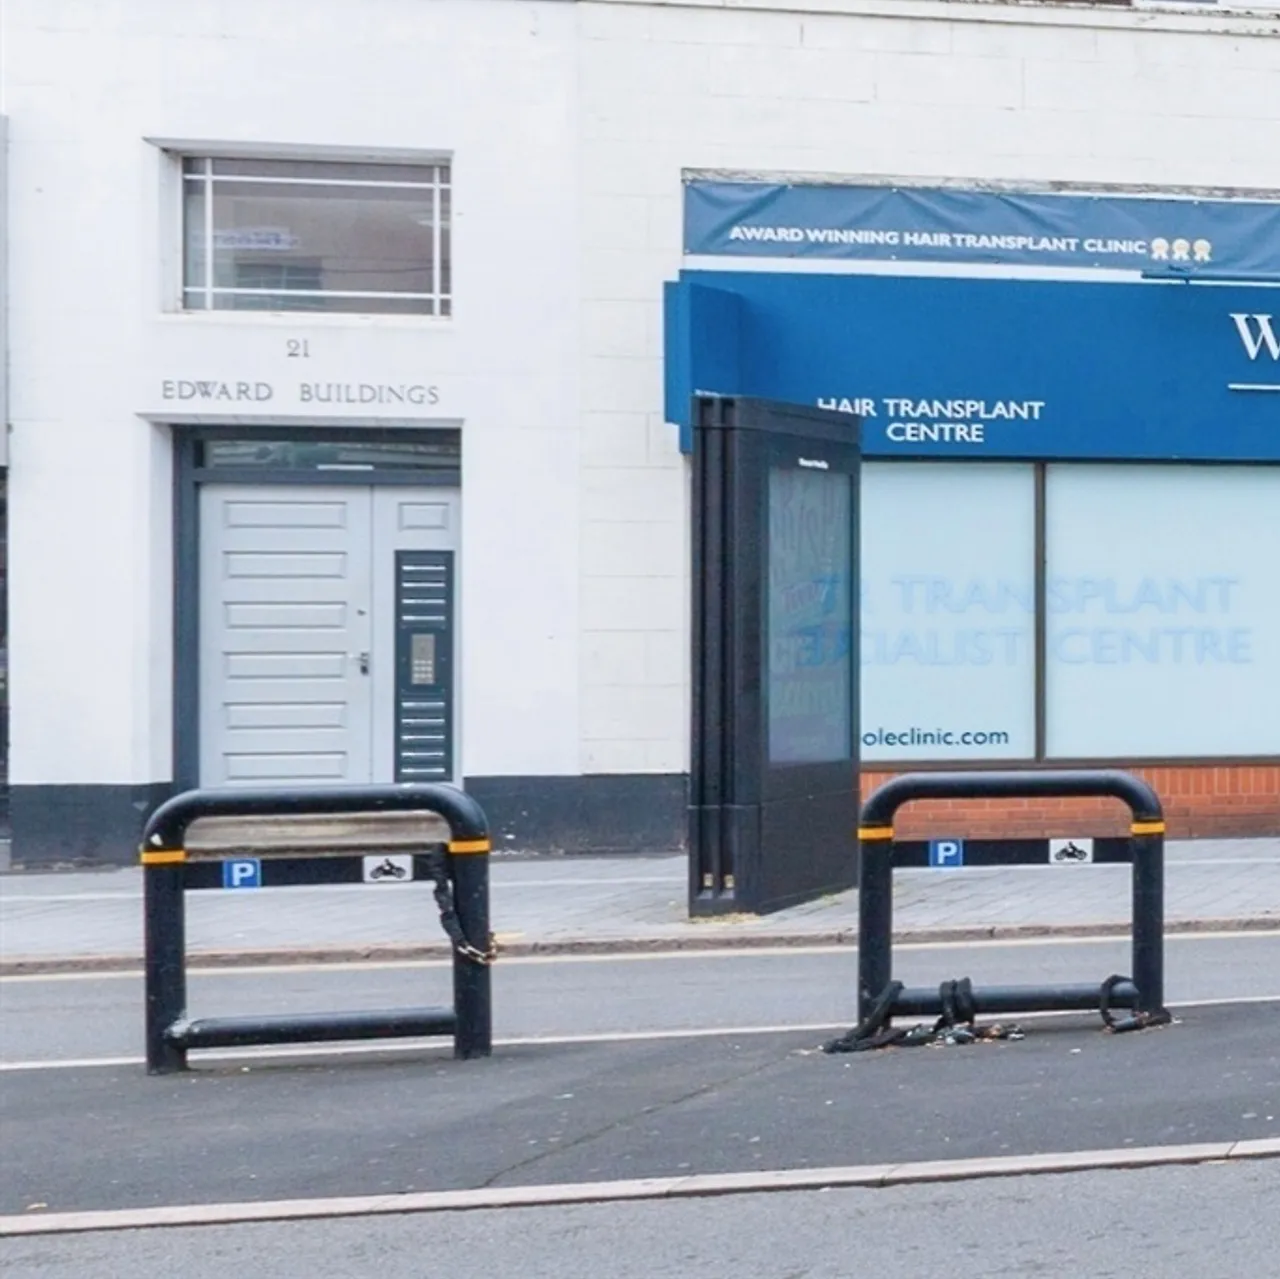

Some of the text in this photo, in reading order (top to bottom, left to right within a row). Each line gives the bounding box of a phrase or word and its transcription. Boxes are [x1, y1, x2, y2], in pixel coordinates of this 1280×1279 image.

[729, 225, 1148, 255] AWARD WINNING HAIR TRANSPLANT CLINIC
[286, 338, 310, 358] 21
[161, 380, 440, 405] EDWARD BUILDINGS
[816, 397, 1046, 420] HAIR TRANSPLANT
[886, 422, 985, 443] CENTRE
[890, 574, 1240, 614] TRANSPLANT
[1055, 625, 1254, 666] CENTRE
[936, 842, 958, 865] P
[231, 862, 254, 887] P
